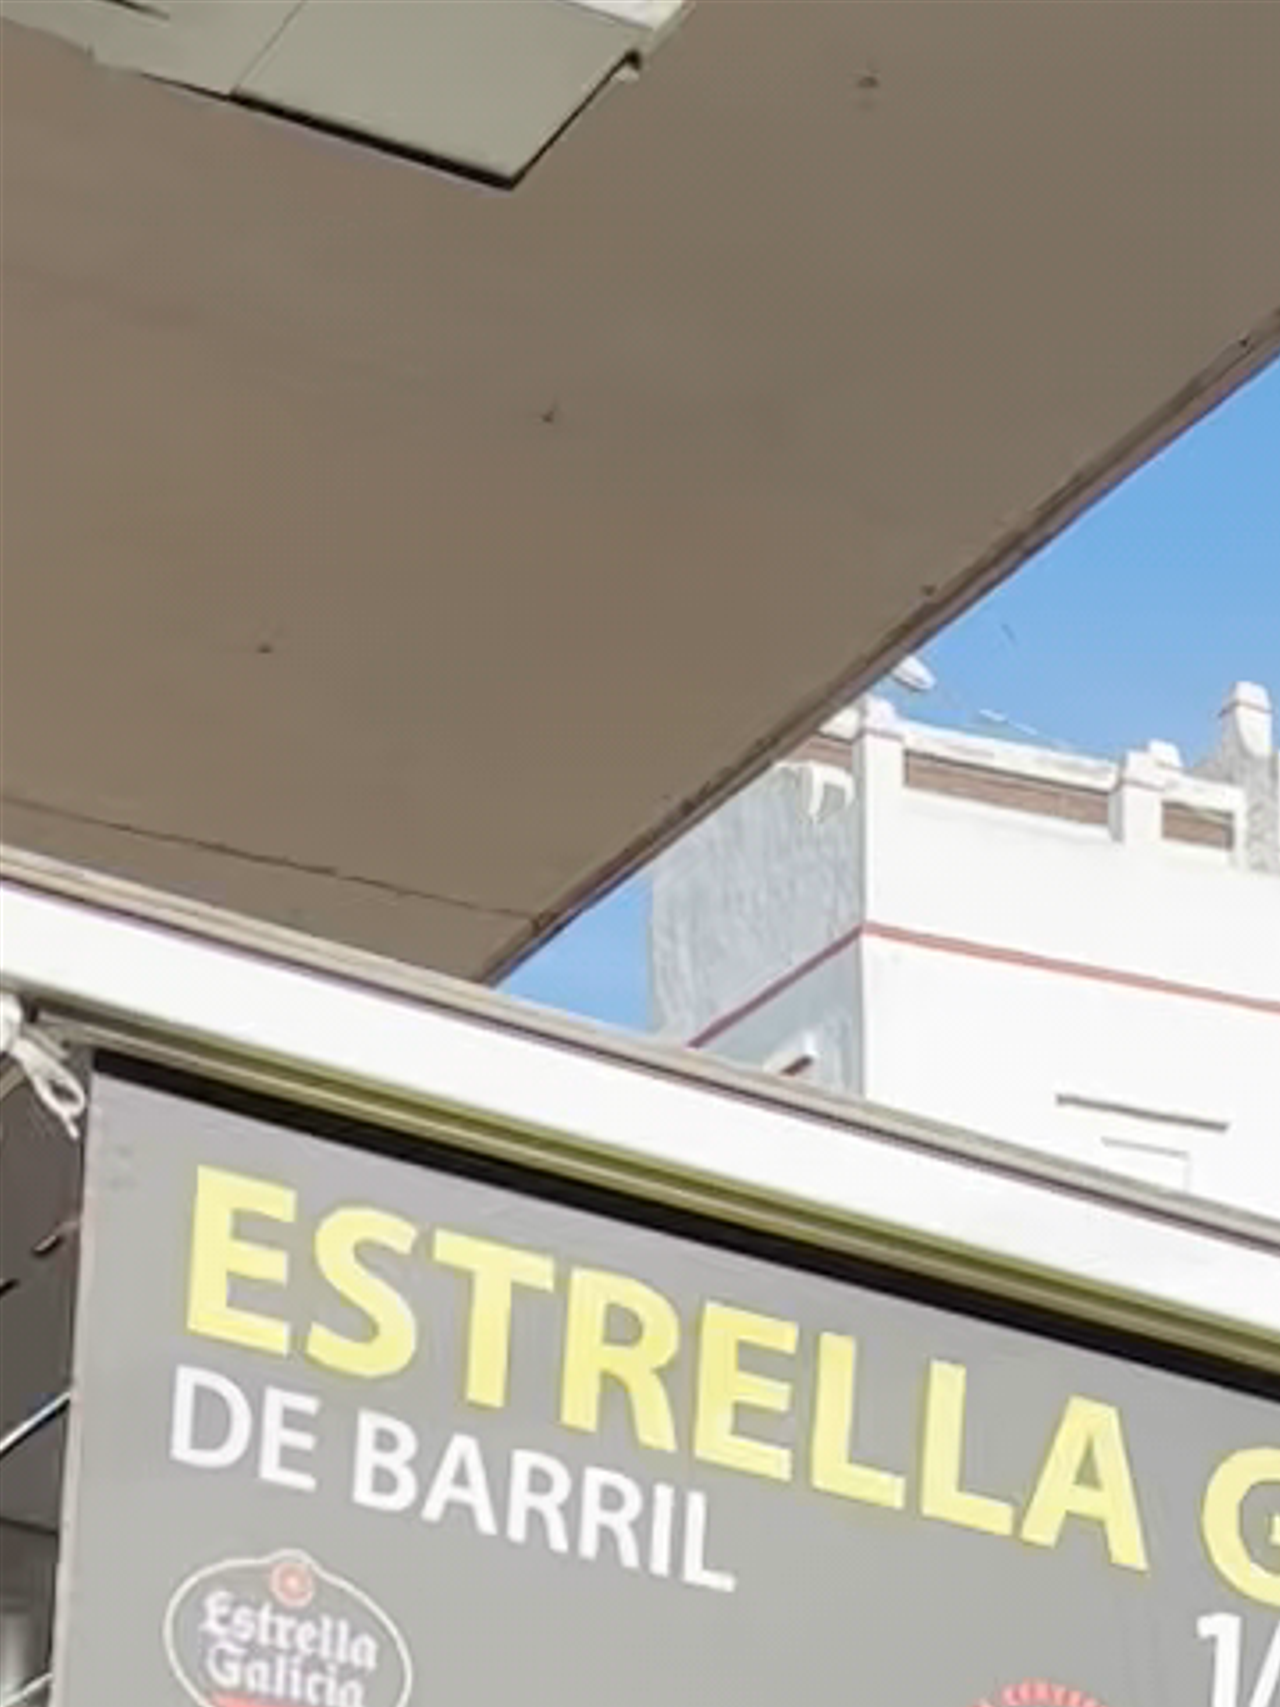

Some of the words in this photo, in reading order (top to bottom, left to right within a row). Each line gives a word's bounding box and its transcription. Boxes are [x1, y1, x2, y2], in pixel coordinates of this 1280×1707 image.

[169, 1364, 320, 1492] DE
[352, 1408, 736, 1593] BARRIL
[187, 1166, 1149, 1572] ESTRELLA
[199, 1590, 378, 1671] Estrella
